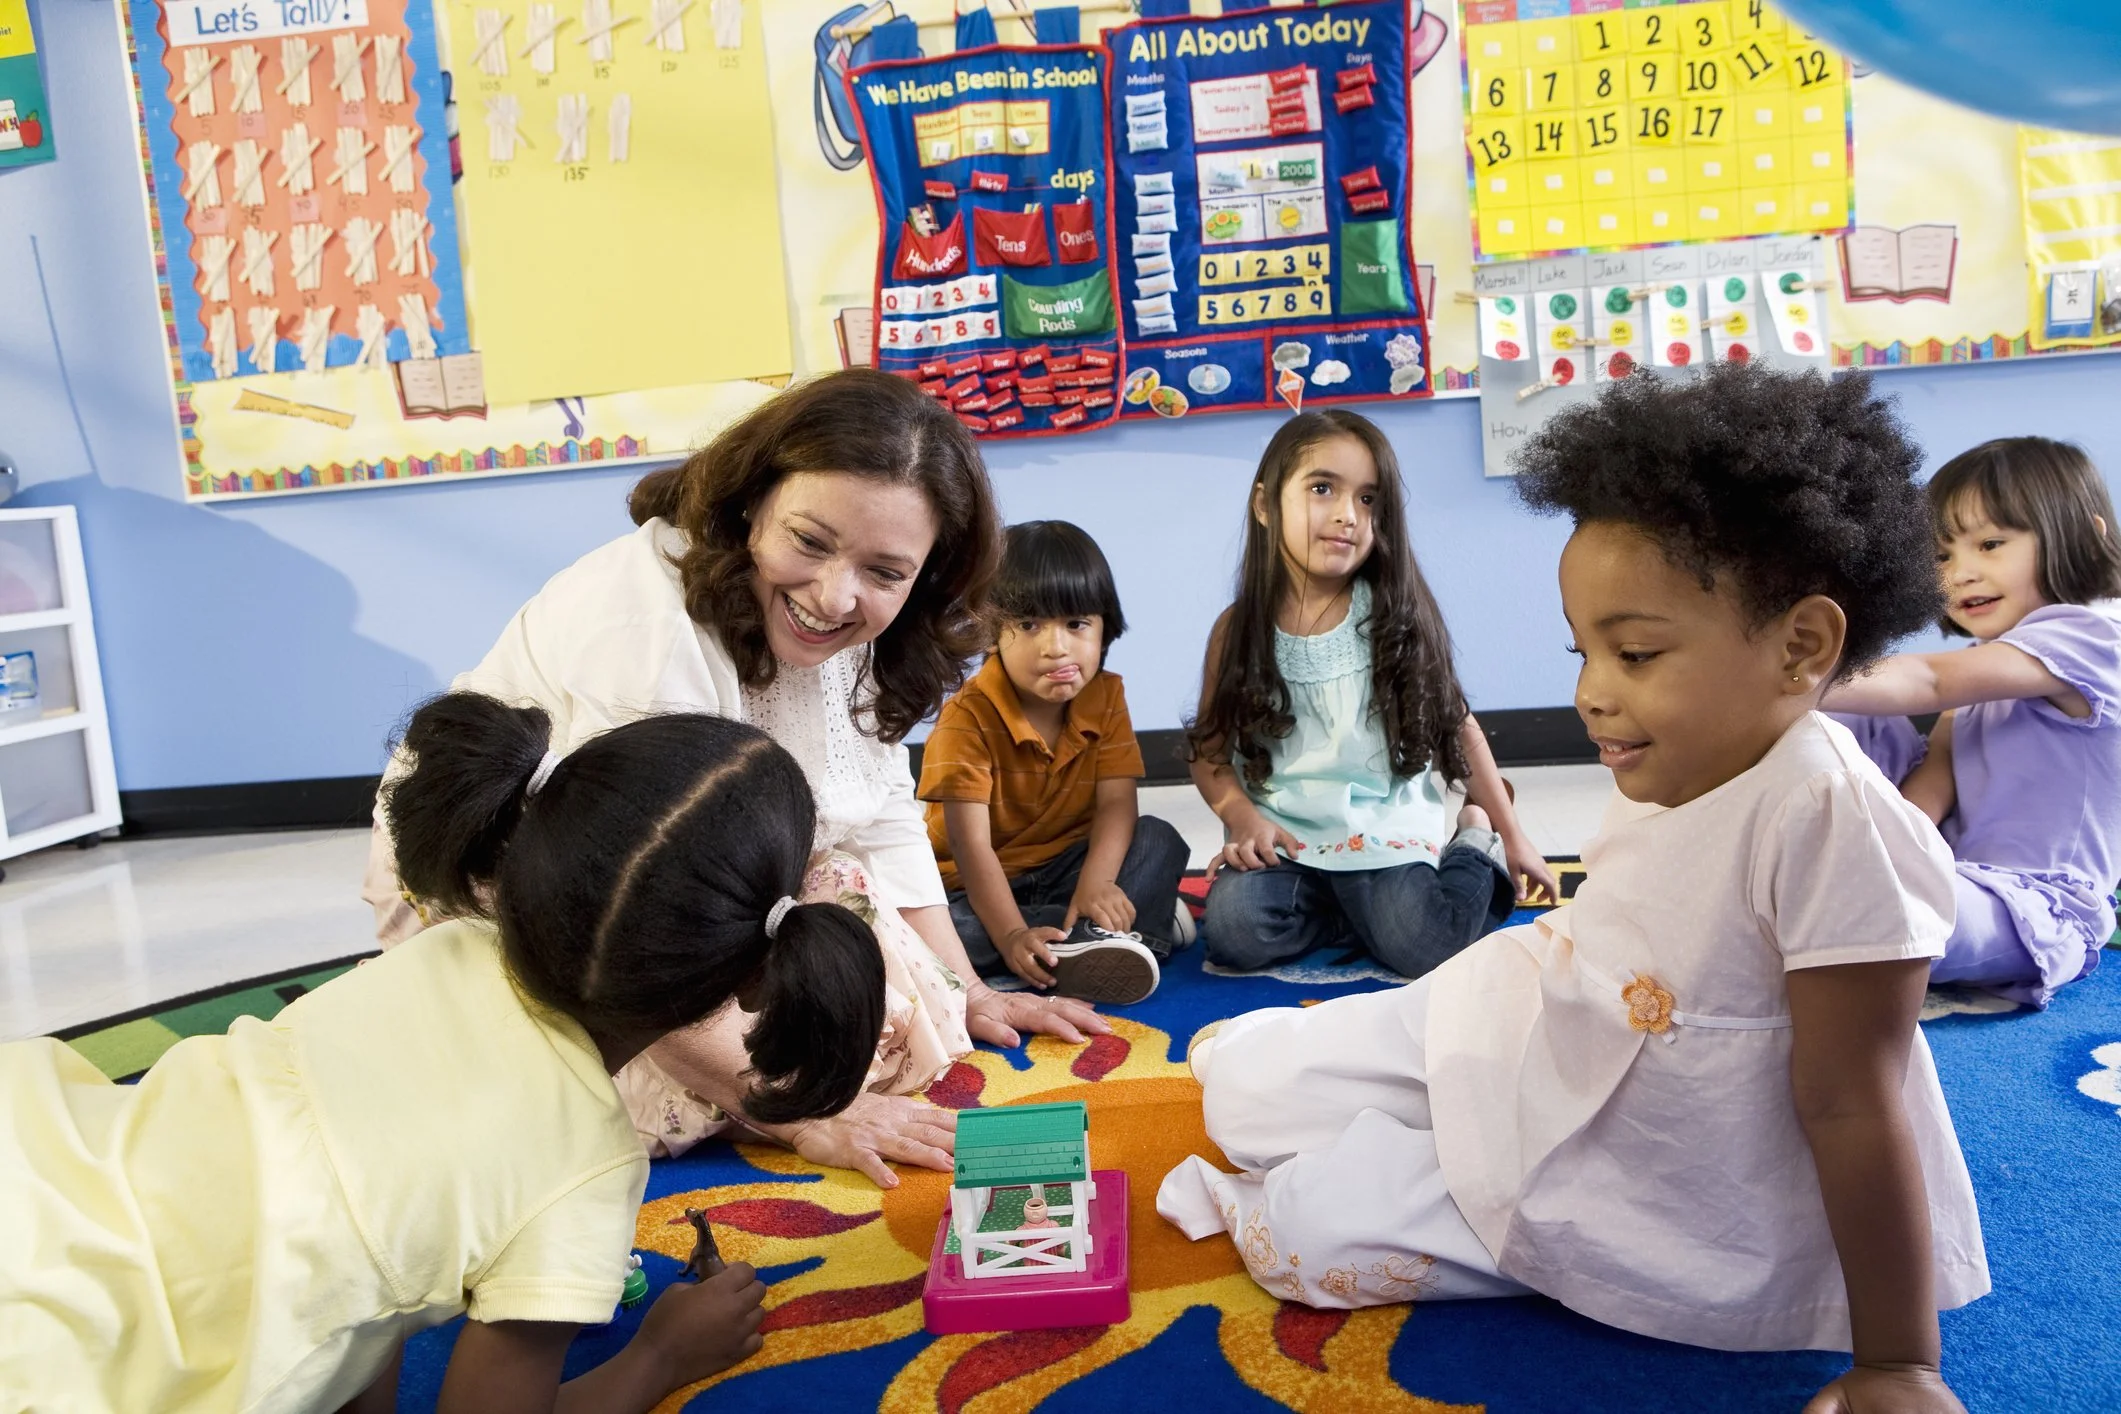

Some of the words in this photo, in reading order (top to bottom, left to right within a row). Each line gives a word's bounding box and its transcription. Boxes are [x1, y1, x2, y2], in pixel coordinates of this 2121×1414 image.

[194, 4, 259, 35] Let's
[280, 0, 352, 27] Tally!
[1595, 20, 1612, 50] 1
[1646, 15, 1662, 46] 2
[1695, 17, 1713, 47] 3
[1748, 0, 1763, 29] 4
[1128, 30, 1167, 63] All
[1175, 22, 1270, 58] About
[1274, 12, 1372, 47] Today
[1346, 52, 1373, 66] Days
[866, 84, 899, 107] We
[899, 80, 954, 103] Have
[954, 70, 1009, 92] Been
[1008, 66, 1029, 89] in
[1031, 65, 1098, 89] School
[1126, 72, 1165, 87] Months
[1488, 77, 1505, 108] 6
[1542, 71, 1559, 103] 7
[1596, 68, 1613, 98] 8
[1640, 61, 1658, 92] 9
[1686, 60, 1718, 91] 10
[1735, 43, 1774, 81] 11
[1794, 50, 1830, 87] 12
[1476, 129, 1512, 168] 13
[1534, 121, 1564, 152] 14
[1587, 112, 1619, 149] 15
[1638, 106, 1671, 139] 16
[1691, 105, 1724, 139] 17
[564, 167, 589, 181] 135
[1050, 168, 1097, 192] days
[1281, 163, 1314, 177] 2008
[995, 234, 1027, 253] Tens
[1059, 230, 1095, 247] Ones
[905, 244, 962, 274] Hundreds
[1204, 261, 1218, 279] 0
[1255, 258, 1269, 277] 2
[1283, 255, 1296, 274] 3
[1307, 251, 1323, 270] 4
[1356, 262, 1388, 275] Years
[1473, 269, 1526, 290] Marshall
[1537, 266, 1568, 286] Luke
[1593, 257, 1629, 280] Jack
[1651, 255, 1688, 276] Sean
[1705, 251, 1750, 272] Dylan
[1761, 242, 1815, 267] Jordan
[885, 295, 898, 310] 0
[915, 293, 922, 309] 1
[932, 291, 946, 306] 2
[952, 287, 965, 302] 3
[979, 282, 991, 298] 4
[1027, 296, 1085, 316] Counting
[1206, 300, 1218, 320] 5
[1232, 298, 1245, 317] 6
[1258, 294, 1271, 314] 7
[1284, 293, 1297, 312] 8
[1310, 290, 1324, 310] 9
[888, 327, 899, 343] 5
[913, 327, 923, 343] 6
[931, 325, 942, 341] 7
[955, 320, 967, 336] 8
[983, 318, 995, 335] 9
[1038, 316, 1077, 334] Rods
[1325, 331, 1369, 346] Weather
[1164, 347, 1208, 360] Seasons
[1490, 421, 1528, 440] How
